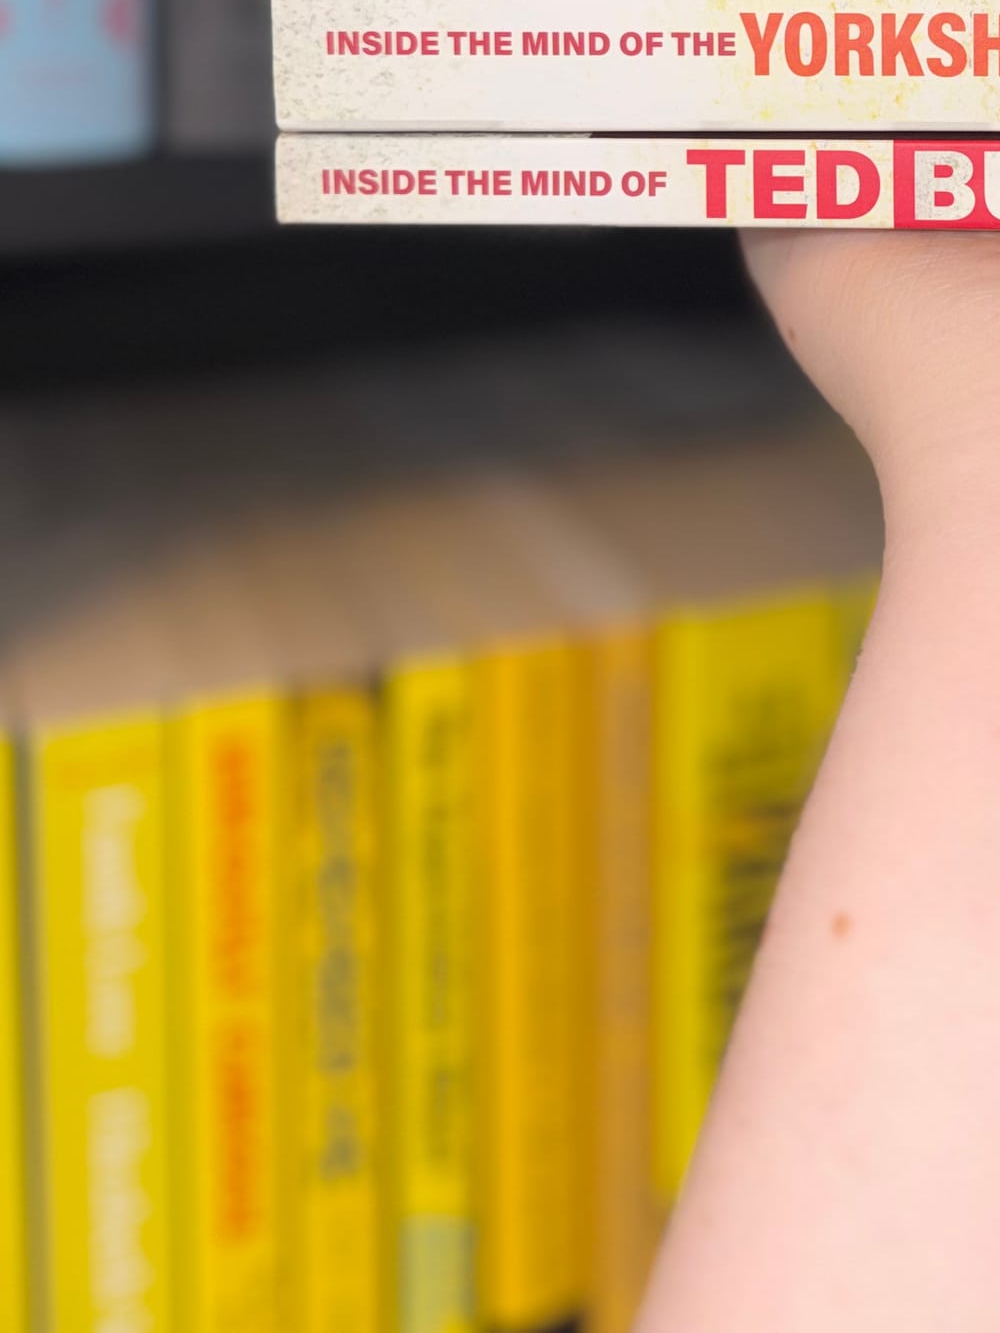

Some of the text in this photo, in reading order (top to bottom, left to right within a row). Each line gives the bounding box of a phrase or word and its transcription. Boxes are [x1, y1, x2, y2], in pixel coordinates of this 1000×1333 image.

[325, 31, 440, 56] INSIDE
[447, 31, 513, 56] THE
[522, 31, 611, 57] MIND
[619, 31, 664, 57] OF
[671, 32, 736, 57] THE
[321, 169, 437, 196] INSIDE
[445, 170, 512, 196] THE
[520, 170, 611, 197] MIND
[620, 170, 667, 197] OF
[686, 149, 881, 220] TED
